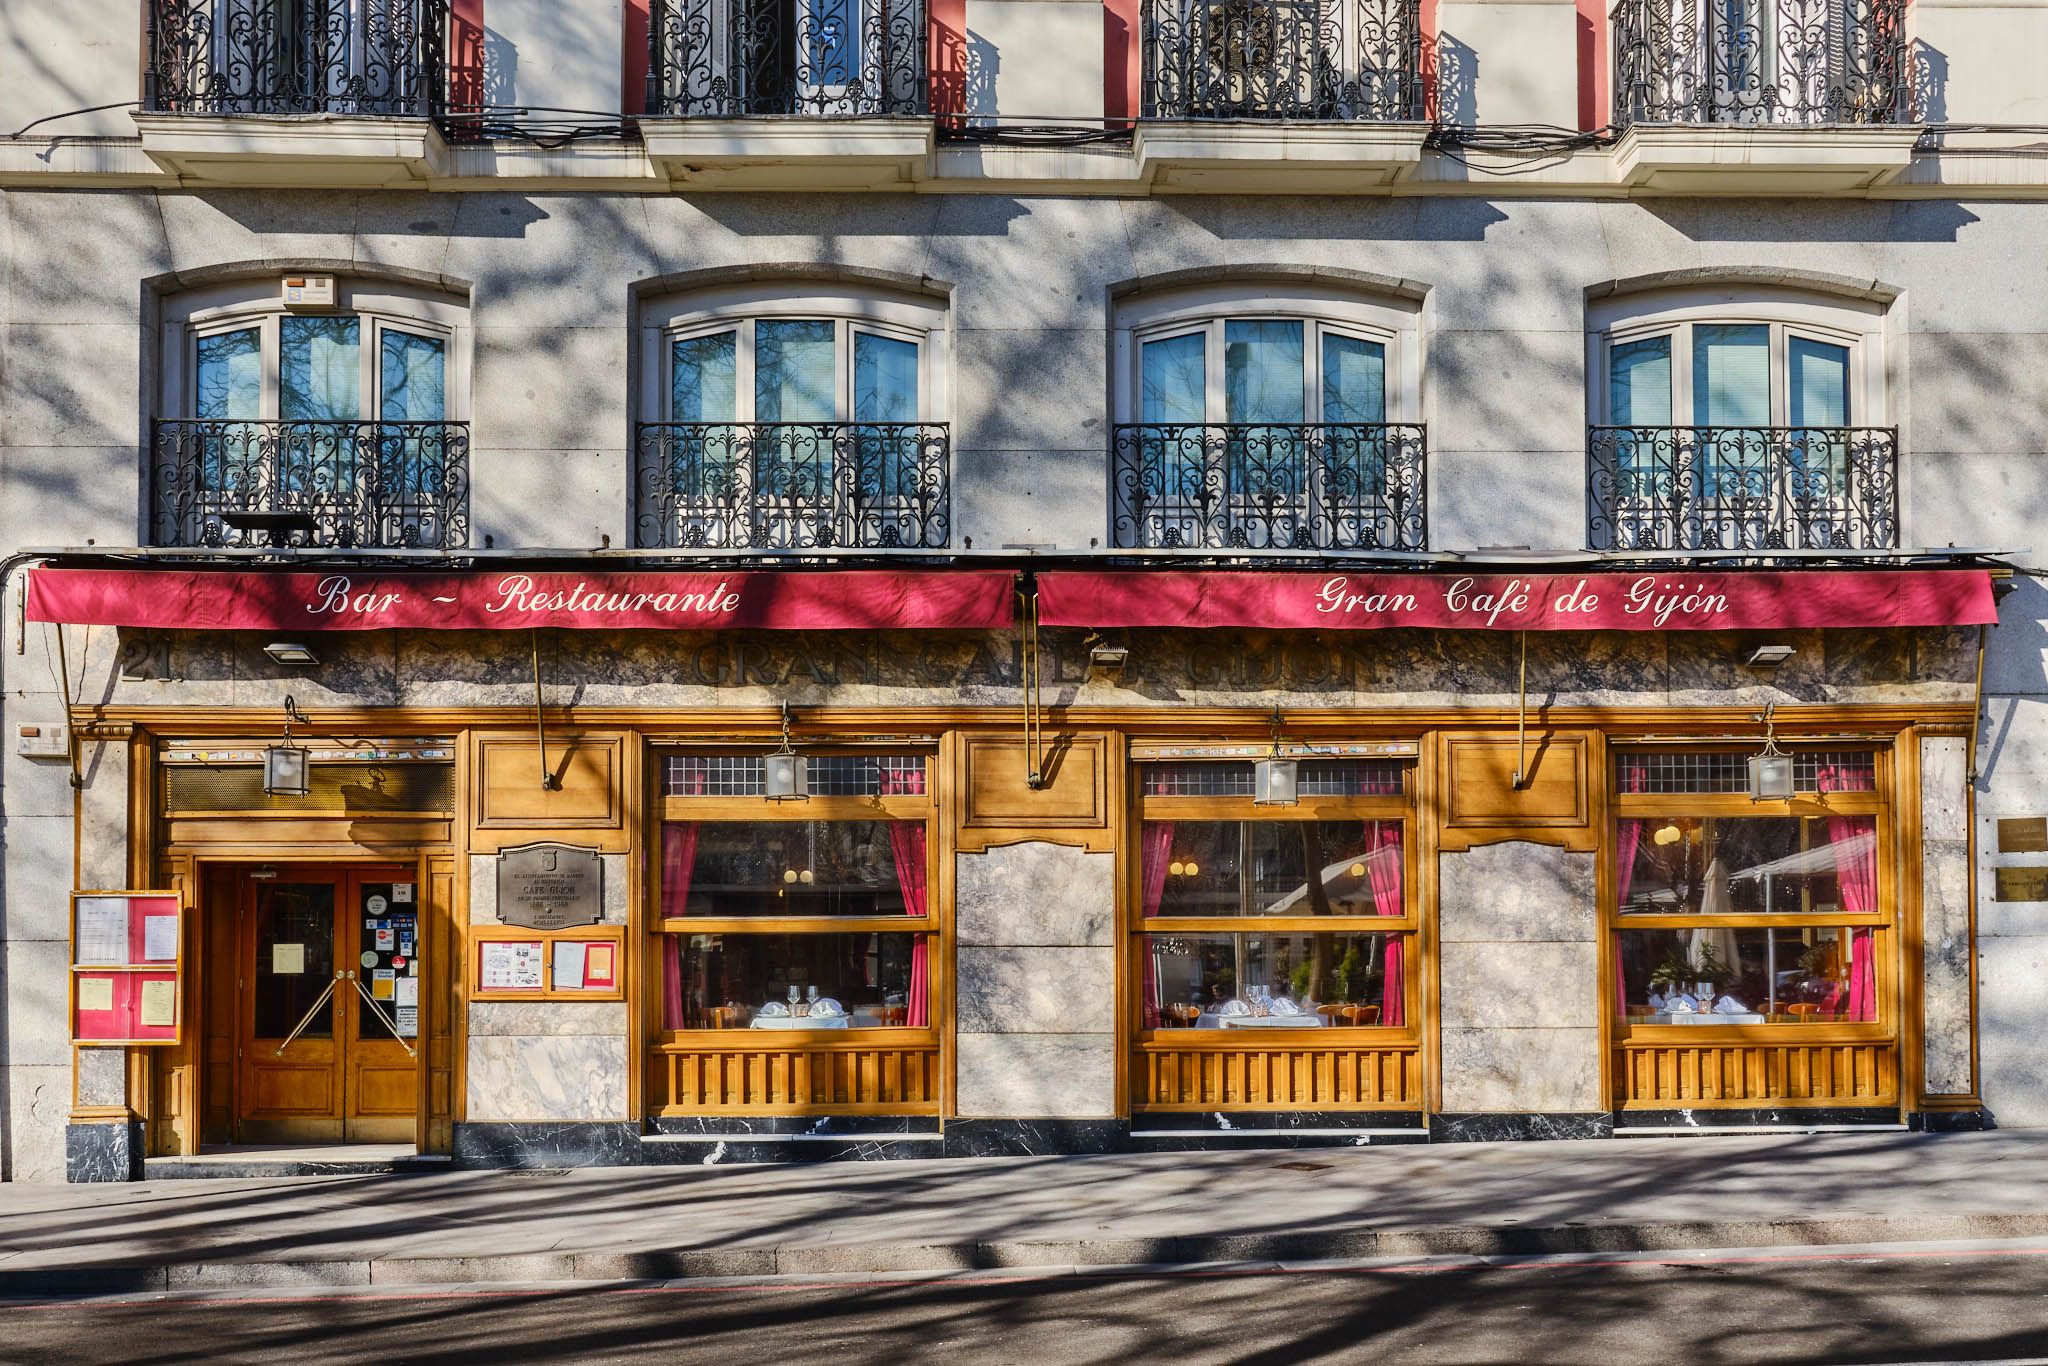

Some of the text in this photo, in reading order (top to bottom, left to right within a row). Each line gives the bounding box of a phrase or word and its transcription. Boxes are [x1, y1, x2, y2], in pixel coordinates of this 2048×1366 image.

[306, 575, 402, 614] Bar
[485, 574, 741, 613] Restaurante
[1315, 576, 1729, 628] Gran Café de Gijón
[690, 638, 873, 686] GRAN
